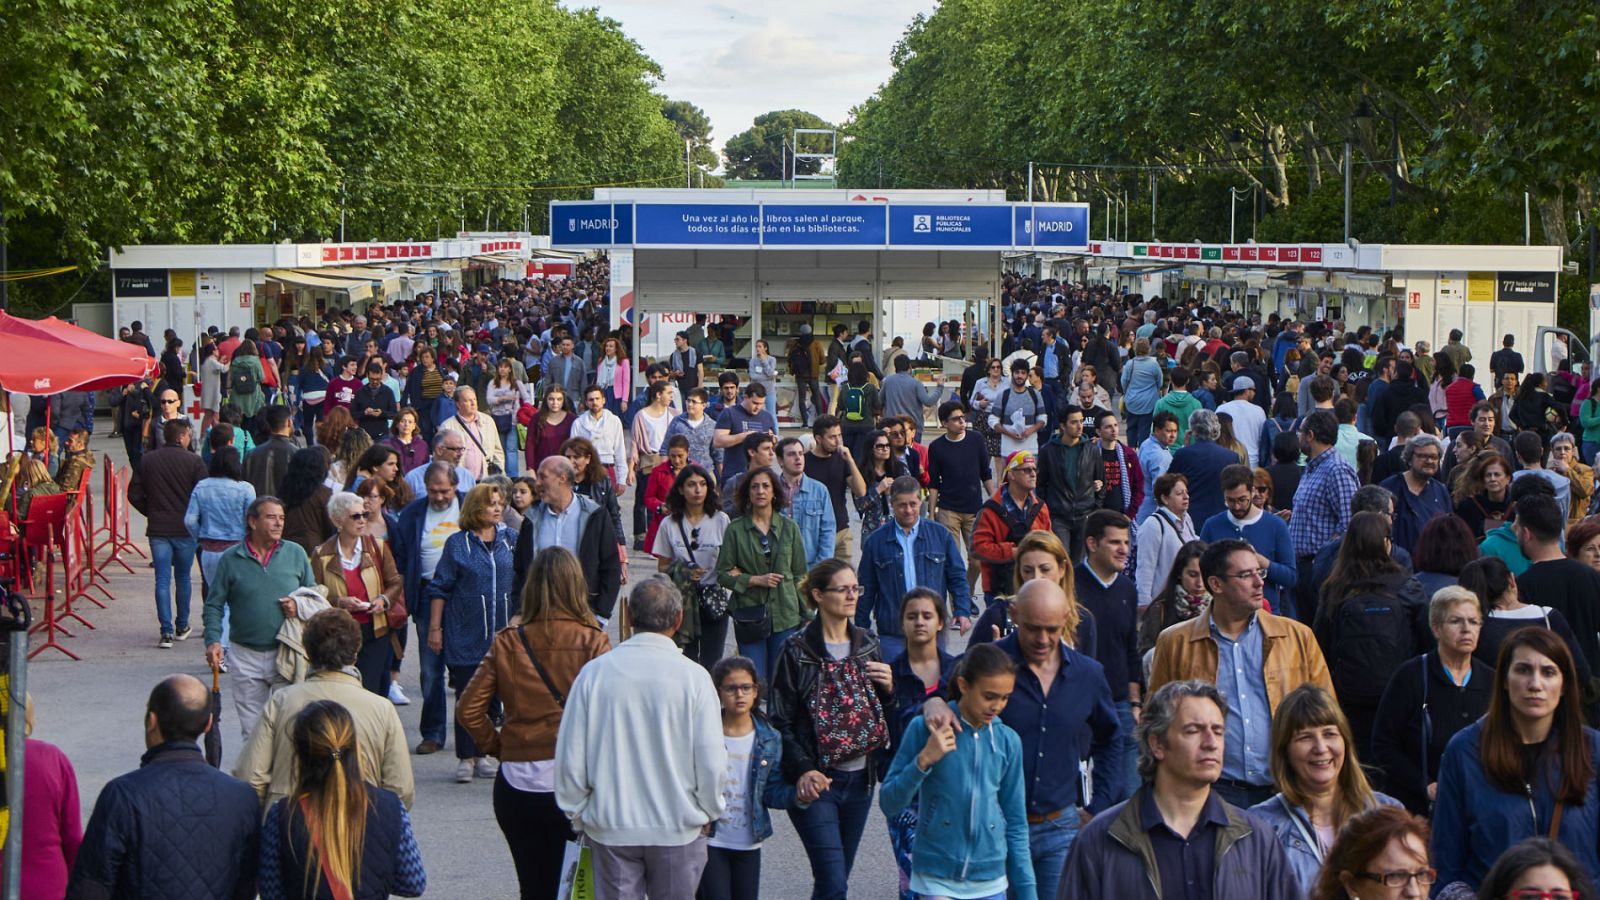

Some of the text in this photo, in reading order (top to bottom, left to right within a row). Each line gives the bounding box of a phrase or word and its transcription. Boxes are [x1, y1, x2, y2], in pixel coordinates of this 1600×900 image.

[580, 218, 619, 231] MADRID
[682, 214, 700, 223] Una
[702, 215, 717, 223] vez
[720, 214, 729, 223] al
[731, 214, 747, 223] año
[766, 214, 792, 223] libros
[794, 214, 818, 223] salen
[820, 214, 829, 223] al
[831, 214, 865, 225] parque,
[687, 224, 712, 233] todos
[715, 224, 729, 233] los
[731, 224, 749, 233] días
[779, 225, 791, 233] en
[793, 224, 806, 233] las
[808, 224, 860, 233] bibliotecas.
[1038, 221, 1073, 232] MADRID
[1287, 250, 1297, 258] 123
[1310, 250, 1321, 259] 122
[120, 277, 131, 289] 77
[1503, 280, 1516, 292] 77
